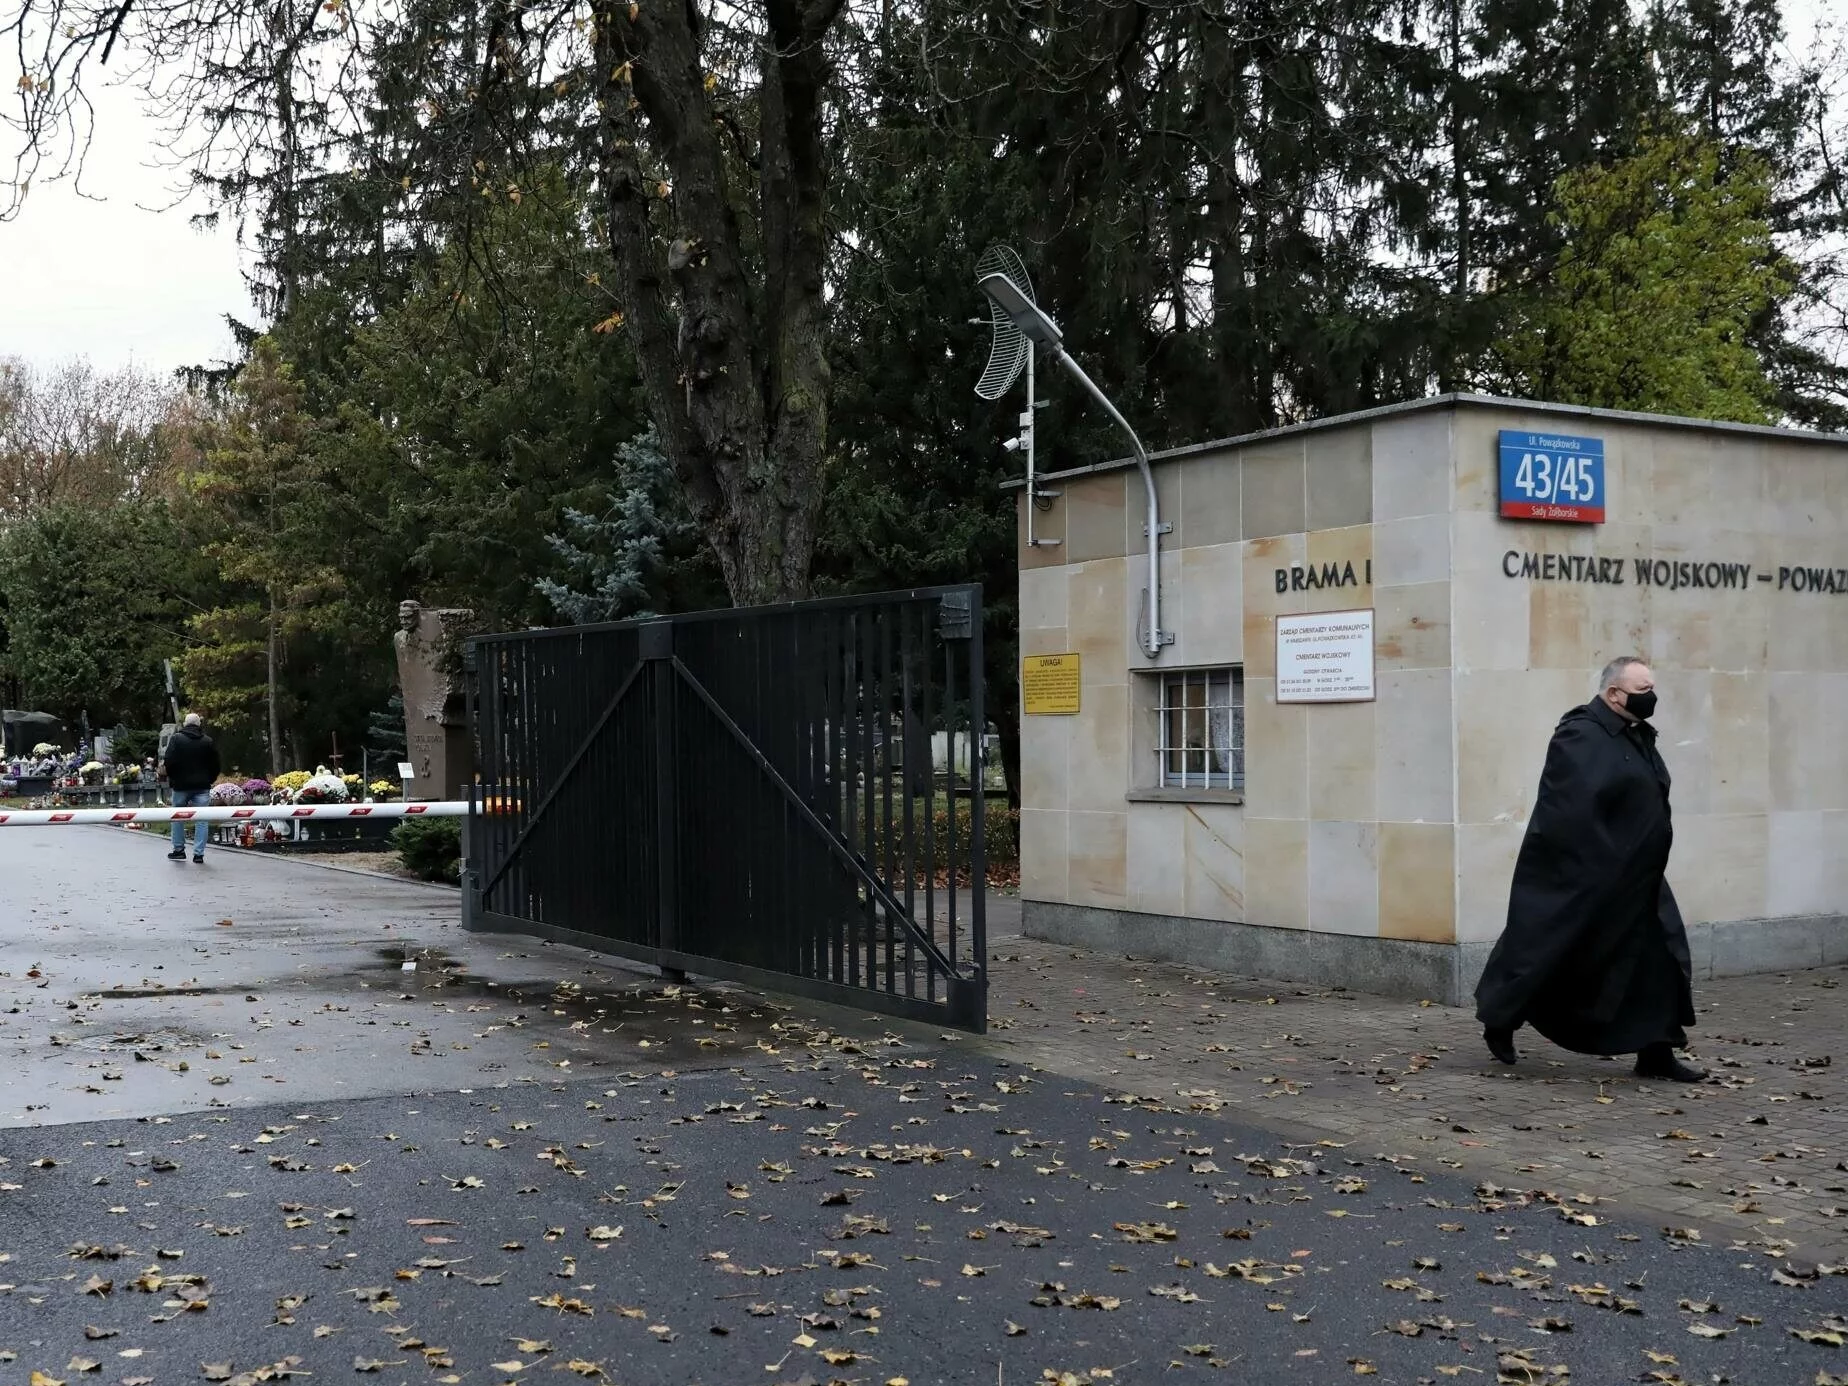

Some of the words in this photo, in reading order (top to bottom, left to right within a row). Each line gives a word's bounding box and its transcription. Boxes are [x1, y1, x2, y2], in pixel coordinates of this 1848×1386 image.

[1539, 436, 1580, 450] Powązkowska
[1515, 453, 1594, 504] 43/45
[1531, 505, 1546, 518] Sady
[1275, 559, 1358, 594] BRAMA
[1365, 559, 1371, 585] I
[1502, 550, 1625, 585] CMENTARZ
[1634, 557, 1751, 591] WOJSKOWY
[1778, 566, 1848, 595] POWĄZ
[1321, 651, 1351, 659] WOJSKOWY
[1040, 658, 1063, 667] UWAGA!
